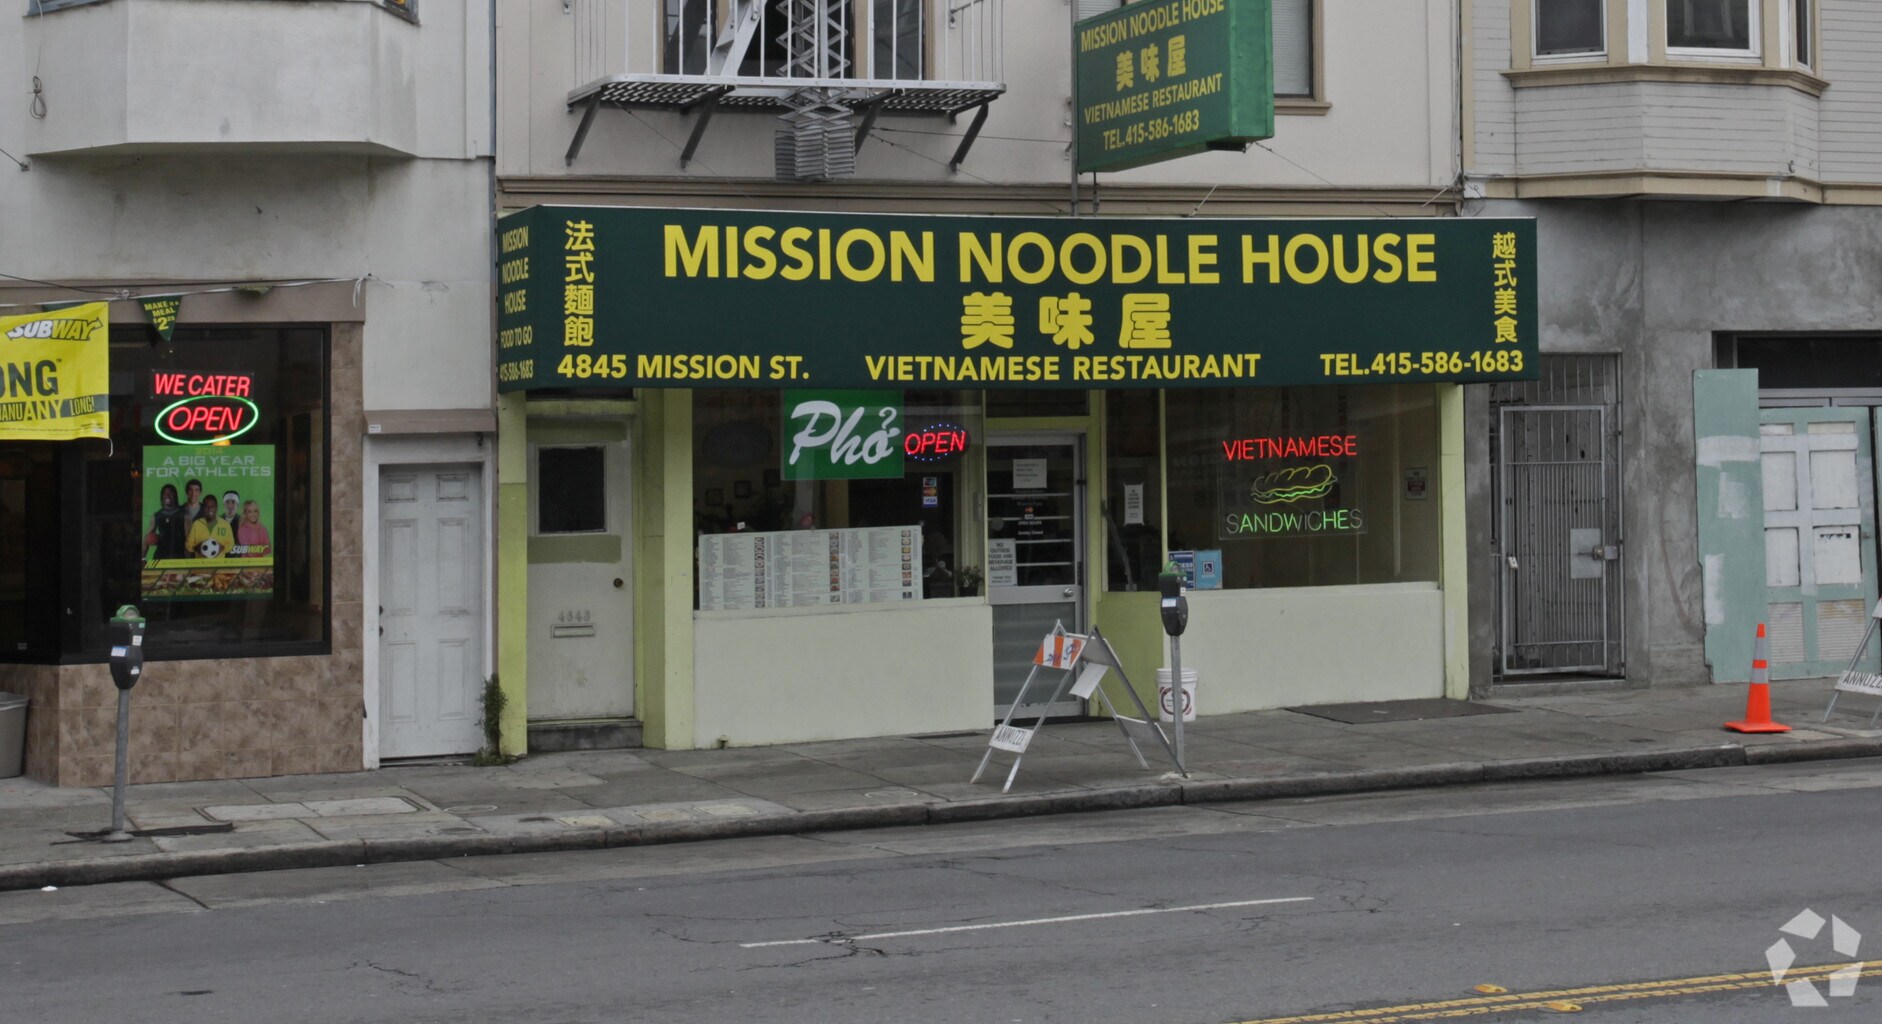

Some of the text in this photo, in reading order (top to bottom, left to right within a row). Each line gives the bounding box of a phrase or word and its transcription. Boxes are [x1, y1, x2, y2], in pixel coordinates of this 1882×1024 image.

[1081, 18, 1127, 52] MISSION
[1130, 2, 1180, 38] NOODLE
[1116, 34, 1186, 91] 美味屋
[1084, 73, 1223, 124] VIETNAMESE RESTAURANT
[1103, 109, 1200, 151] TEL.415-586-1683
[502, 226, 529, 254] MISSION
[663, 224, 1437, 285] MISSION NOODLE HOUSE
[502, 257, 529, 284] NOODLE
[1492, 231, 1518, 344] 越式美食
[144, 301, 168, 311] MAKE
[152, 307, 176, 317] MEAL
[504, 289, 527, 314] HOUSE
[6, 317, 103, 341] SUBWAY
[960, 291, 1172, 350] 美味屋
[501, 325, 533, 349] FOOD TO GO
[557, 353, 810, 380] 4845 MISSION ST.
[864, 352, 1262, 381] VIETNAMESE RESTAURANT
[1319, 350, 1524, 377] TEL.415-586-1683
[0, 359, 59, 397] NG
[154, 373, 251, 397] WE CATER
[69, 396, 95, 416] LONG!
[167, 405, 243, 432] OPEN
[904, 431, 967, 454] OPEN
[1222, 434, 1358, 461] VIETNAMESE
[146, 466, 272, 477] FOR ATHLETES
[163, 455, 255, 466] A BIG YEAR
[1226, 508, 1362, 534] SANDWICHES
[229, 544, 270, 555] SUBWAY
